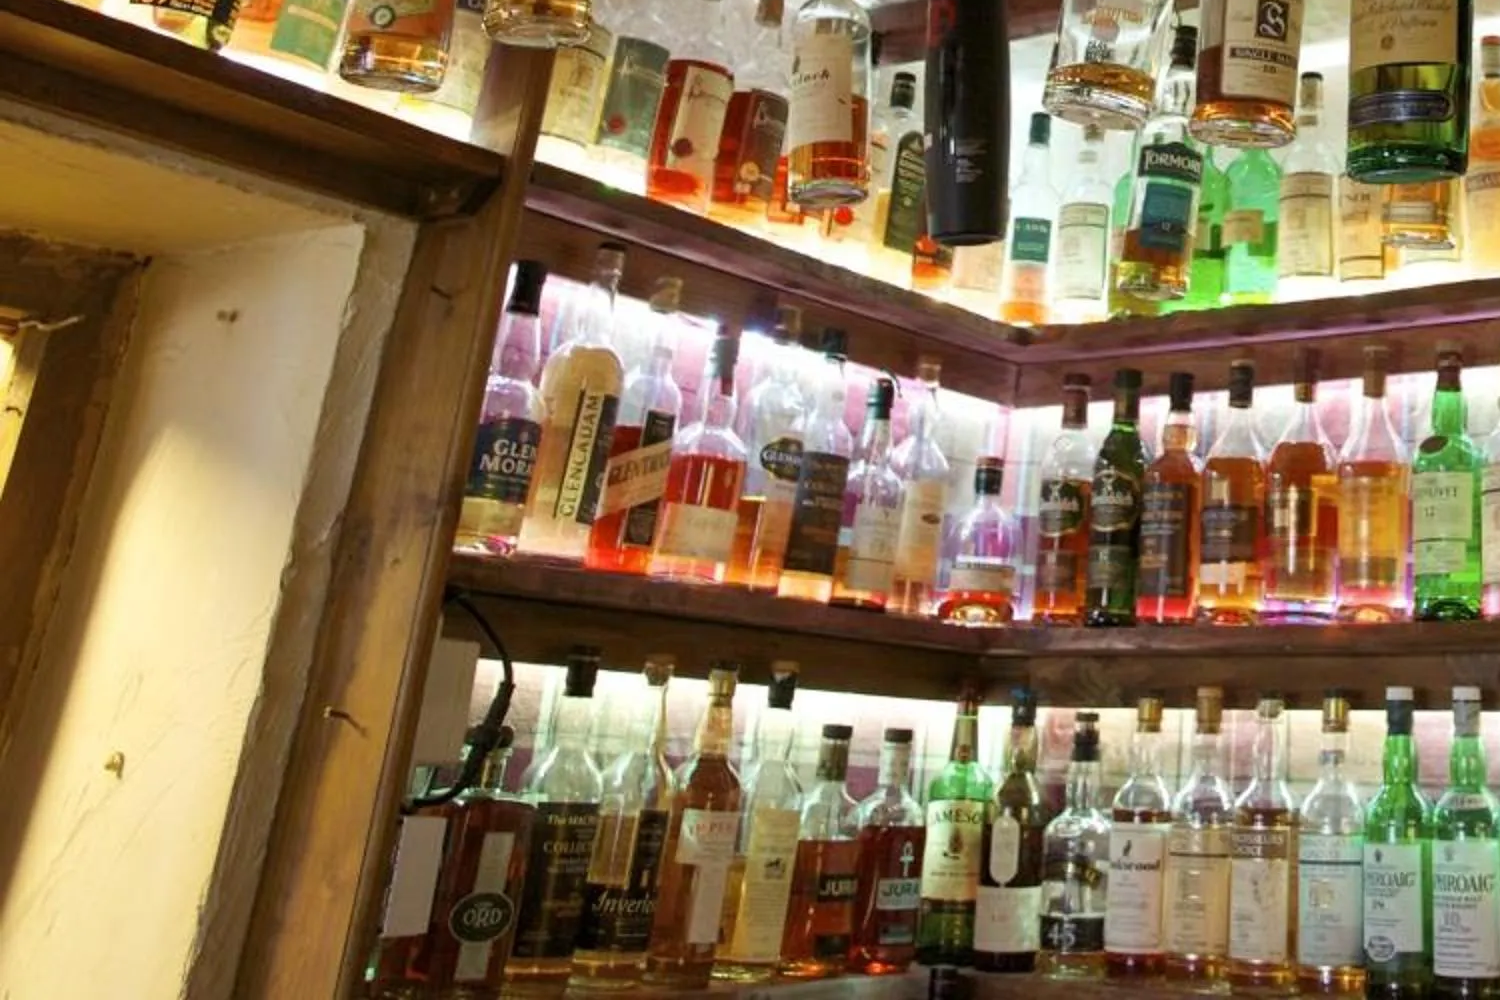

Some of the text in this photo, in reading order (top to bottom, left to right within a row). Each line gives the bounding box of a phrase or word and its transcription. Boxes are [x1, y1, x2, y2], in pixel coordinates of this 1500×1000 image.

[1144, 150, 1201, 173] TORMOR
[493, 439, 537, 460] GLEN
[559, 394, 600, 517] GLENCADAM
[479, 453, 534, 476] MOR
[820, 879, 858, 897] JUR
[463, 906, 502, 928] ORD
[1048, 921, 1077, 948] 45
